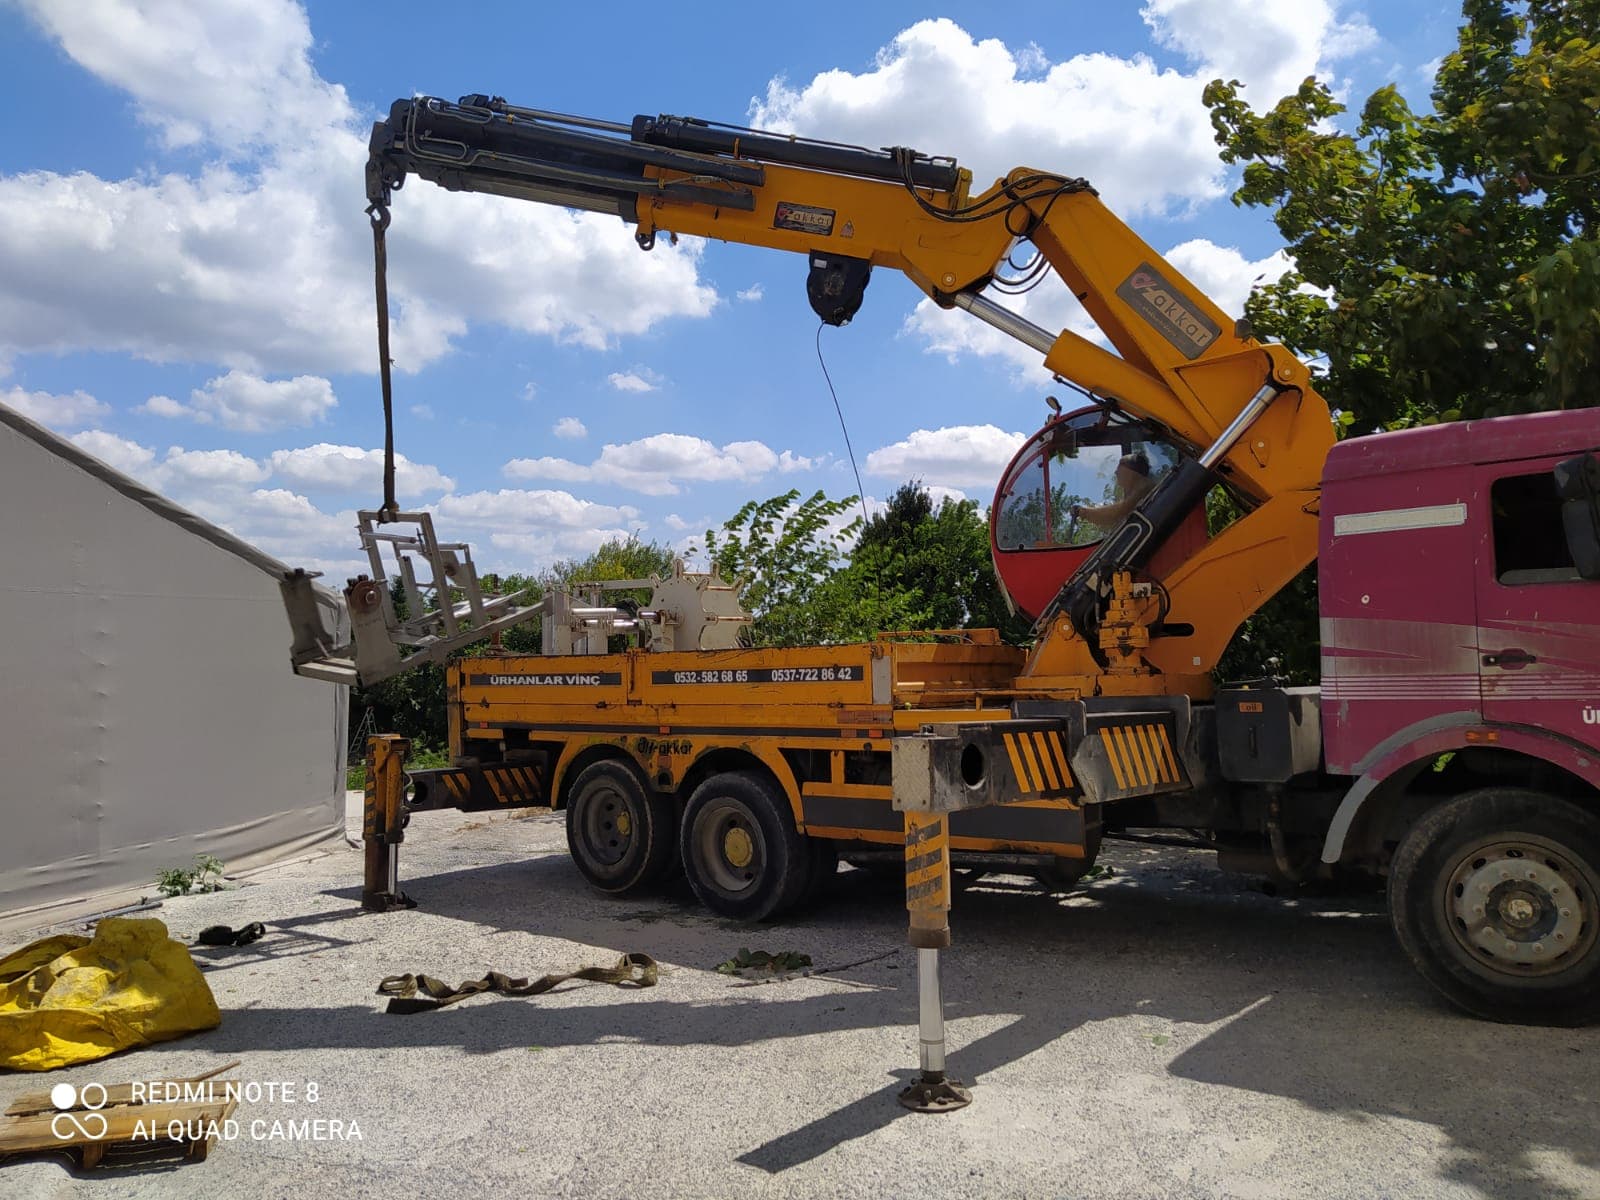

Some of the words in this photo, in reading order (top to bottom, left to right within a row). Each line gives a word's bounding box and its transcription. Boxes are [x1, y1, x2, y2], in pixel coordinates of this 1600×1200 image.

[489, 674, 563, 686] ÜRHANLAR
[564, 673, 601, 686] VİNÇ
[721, 670, 733, 682] 68
[735, 670, 748, 682] 65
[821, 667, 835, 681] 86
[837, 667, 852, 680] 42
